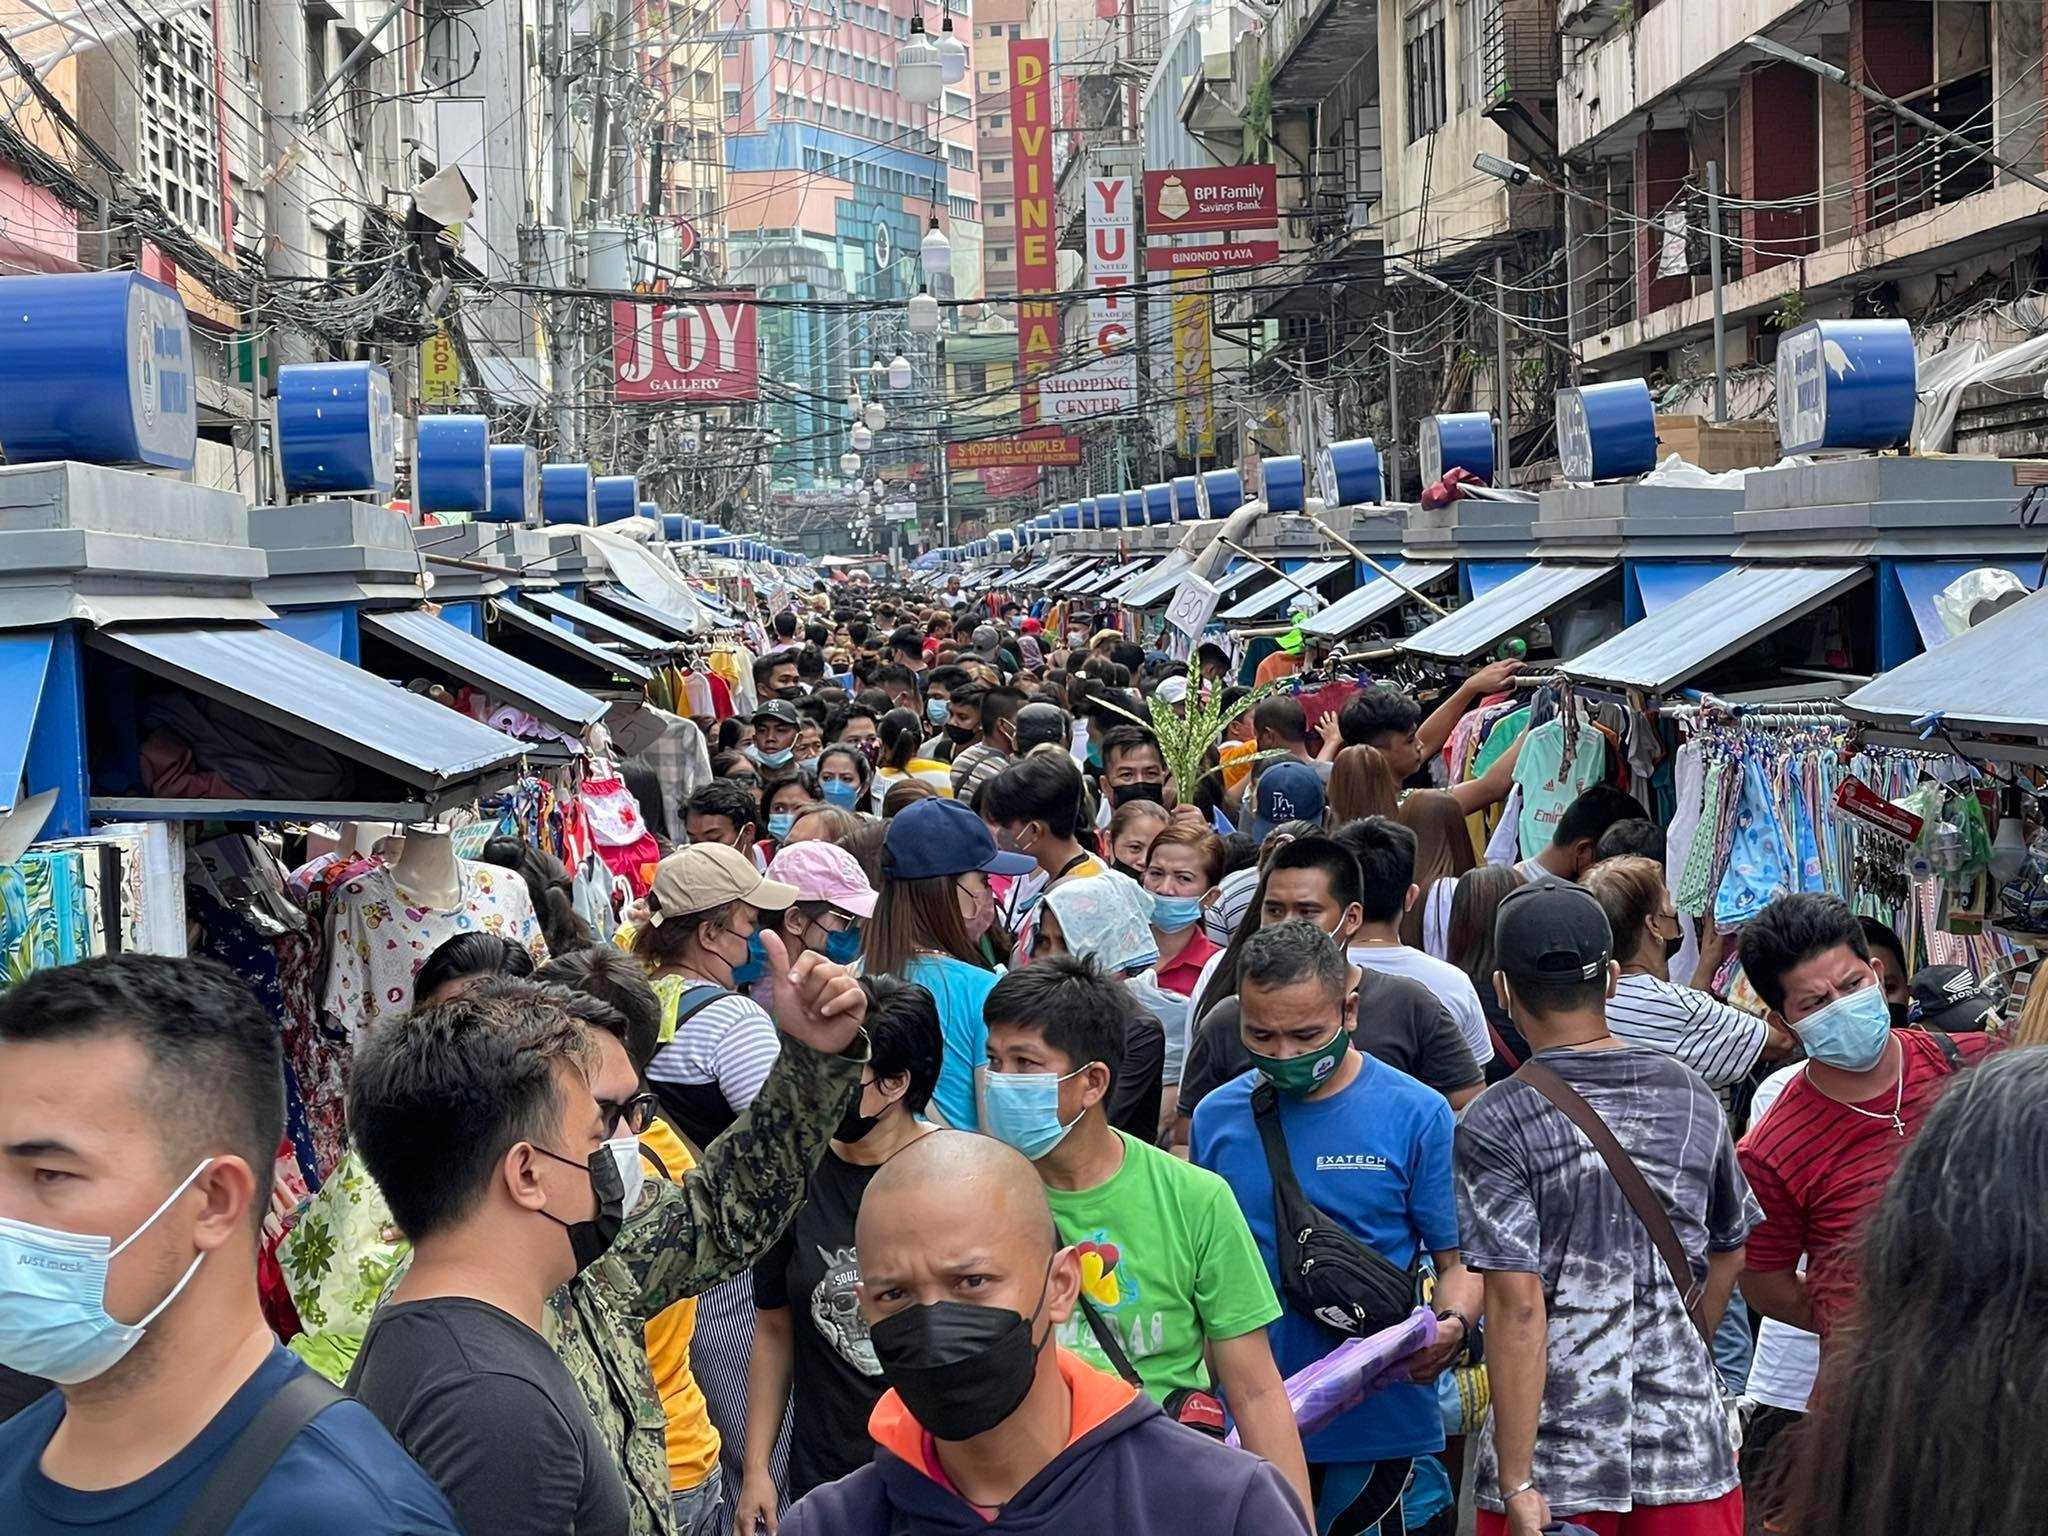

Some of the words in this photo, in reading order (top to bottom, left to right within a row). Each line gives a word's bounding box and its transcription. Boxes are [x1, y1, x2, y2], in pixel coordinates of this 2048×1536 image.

[1017, 56, 1047, 266] DIVINE
[1194, 187, 1216, 201] BPI
[1221, 183, 1264, 200] Family
[1200, 203, 1235, 214] Savings
[1237, 201, 1260, 211] Bank
[1172, 250, 1219, 263] BINONDO
[1222, 249, 1253, 260] YLAYA
[619, 303, 745, 382] JOY
[650, 378, 722, 390] GALLERY
[1046, 376, 1129, 392] SHOPPING
[1055, 398, 1121, 415] CENTER
[958, 441, 1011, 457] SHOPPING
[1014, 439, 1067, 455] COMPLEX
[1173, 587, 1203, 625] 130
[1534, 808, 1563, 824] Emir
[1947, 987, 1982, 1004] HOND
[1316, 1155, 1387, 1165] EXATECH
[834, 1269, 859, 1286] SOUL
